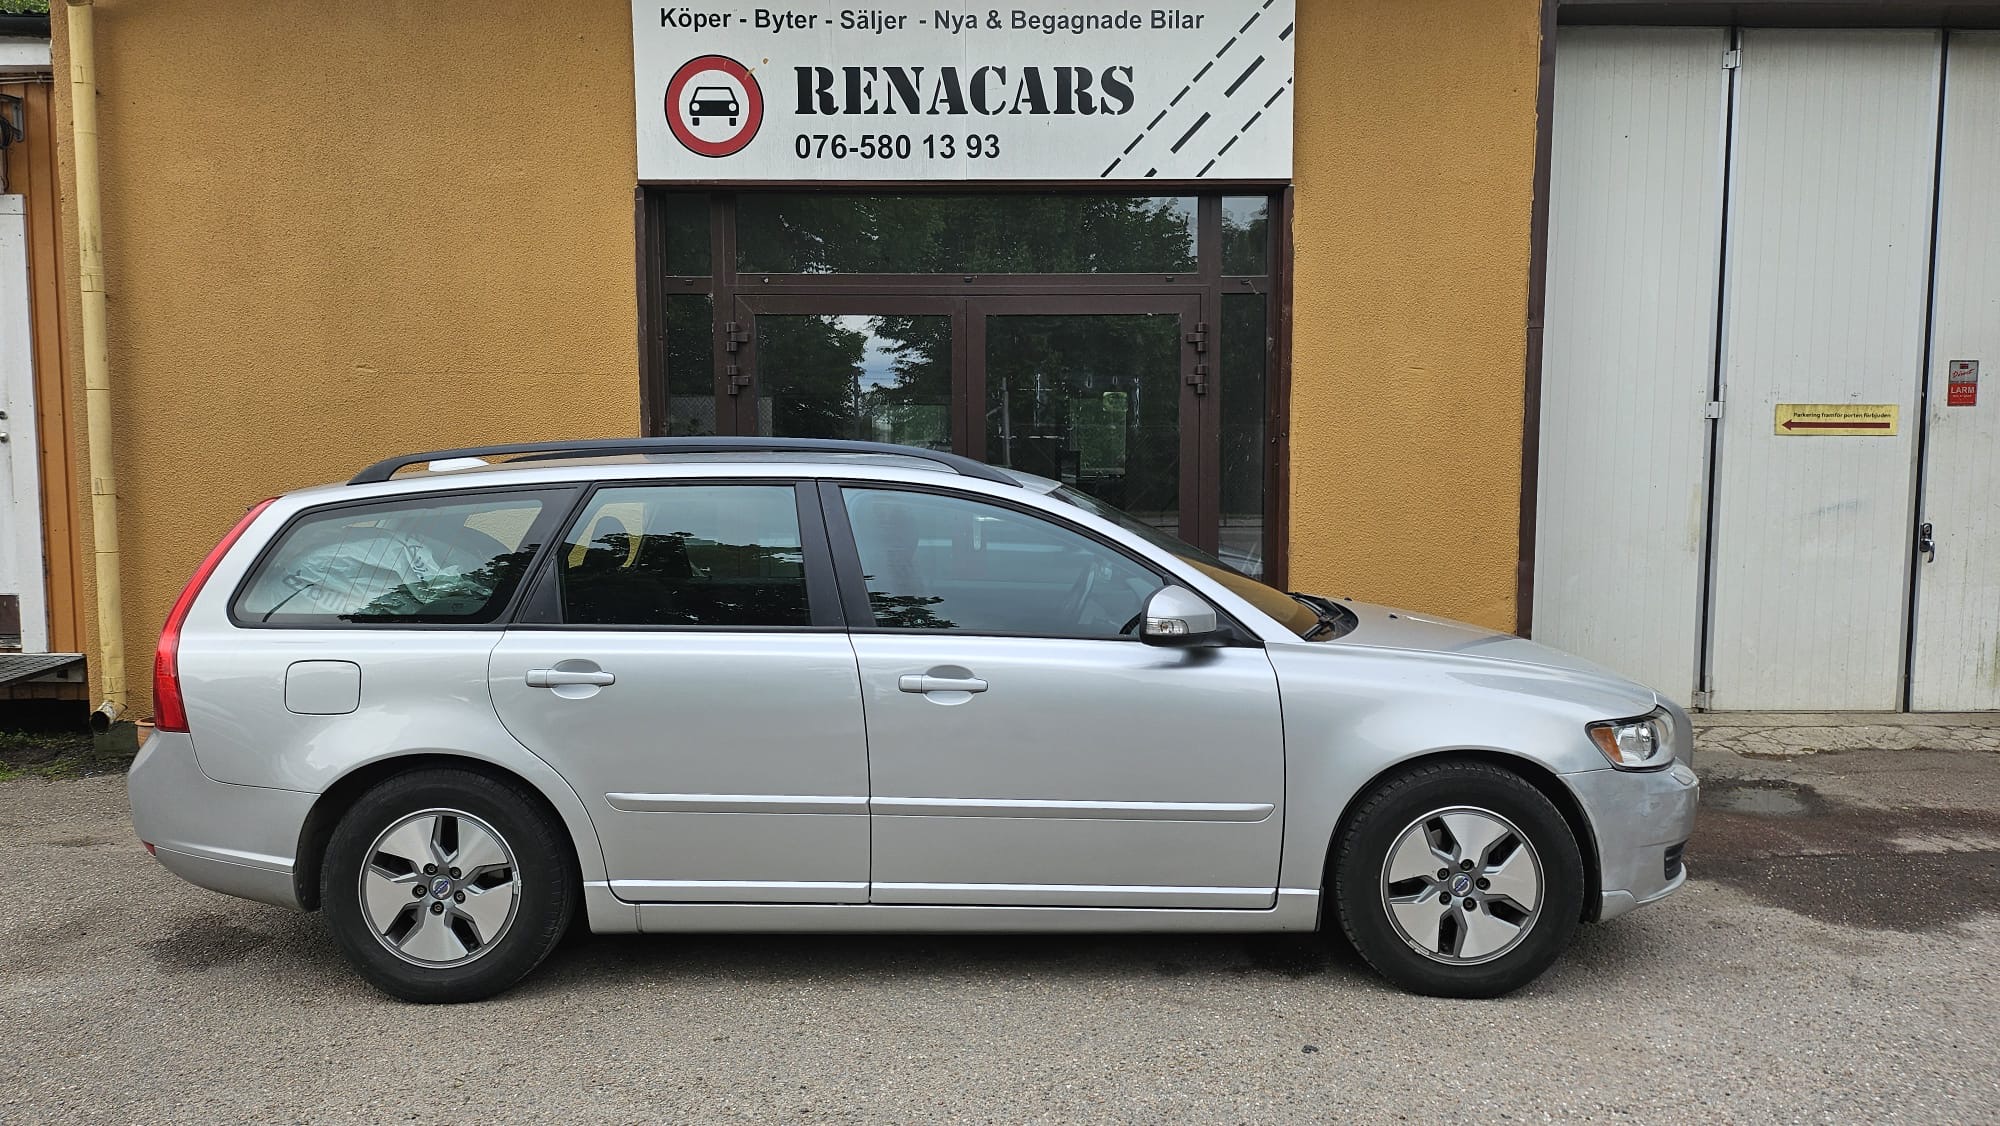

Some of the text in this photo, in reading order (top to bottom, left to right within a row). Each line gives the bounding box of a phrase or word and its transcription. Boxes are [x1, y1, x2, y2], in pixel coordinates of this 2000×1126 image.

[660, 7, 732, 32] Köper
[754, 8, 818, 33] Byter
[840, 9, 908, 34] Säljer
[934, 9, 978, 34] Nya
[986, 9, 1003, 30] &
[1011, 9, 1142, 34] Begagnade
[1150, 9, 1205, 29] Bilar
[793, 65, 1135, 116] RENACARS
[795, 133, 1000, 160] 076-580 13 93
[1951, 386, 1975, 394] LARM
